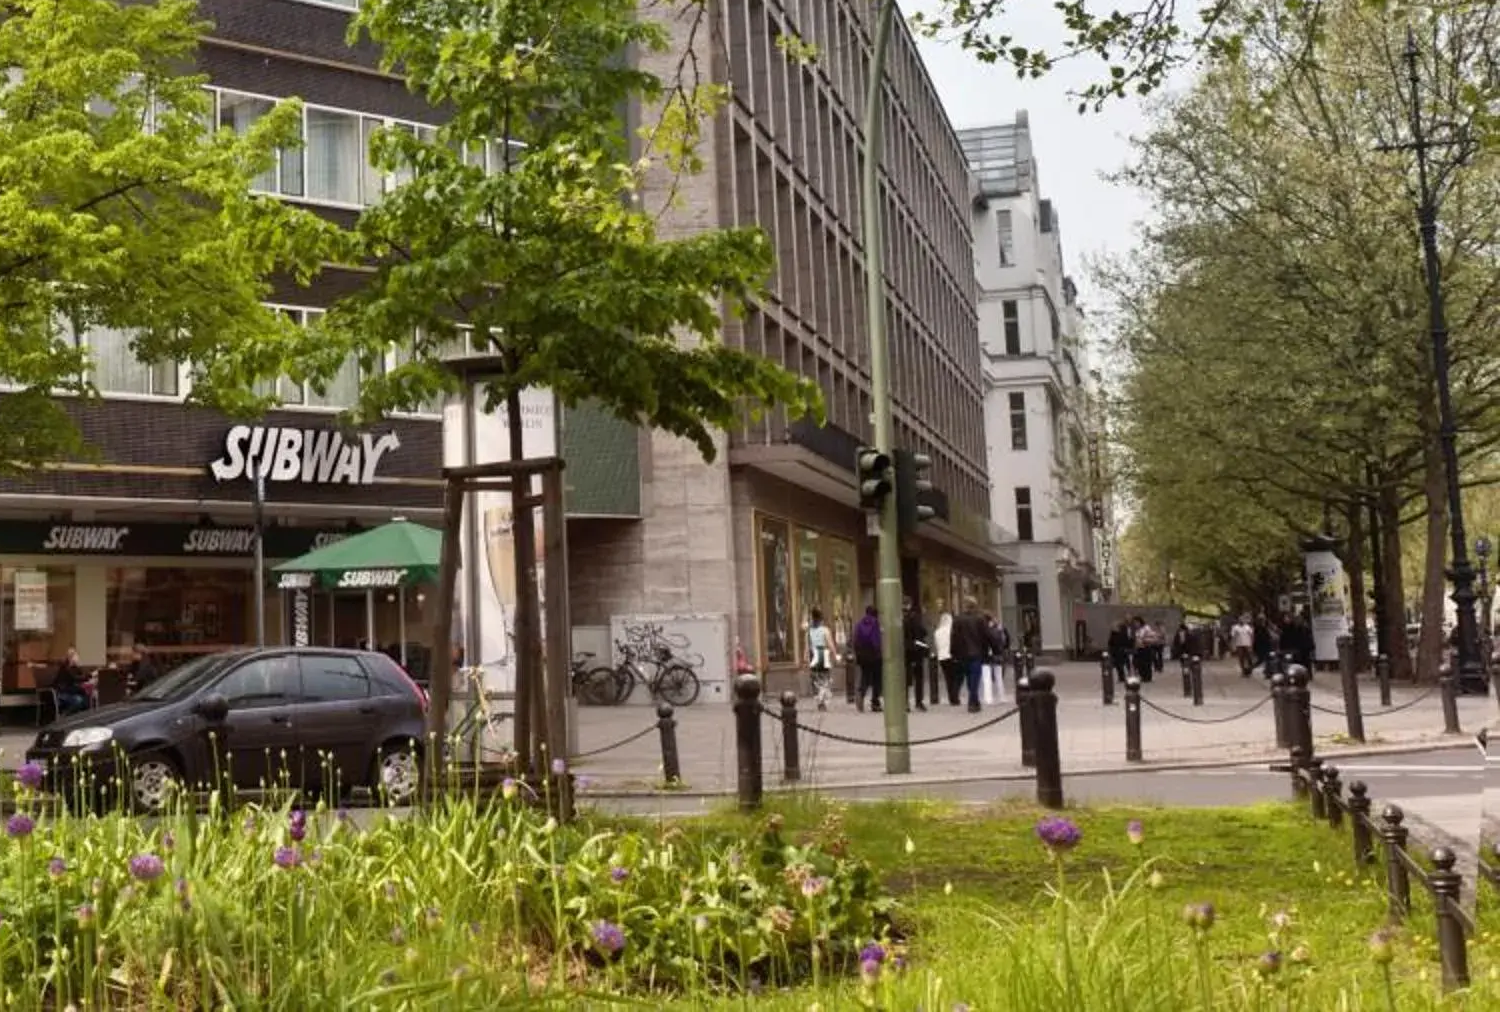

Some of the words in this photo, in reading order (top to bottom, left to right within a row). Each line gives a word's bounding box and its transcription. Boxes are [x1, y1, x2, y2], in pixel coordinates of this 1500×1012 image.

[211, 425, 400, 485] SUBWAY
[44, 527, 129, 549] SUBWAY
[183, 529, 260, 552] SUBWAY
[337, 569, 409, 588] SUBWAY
